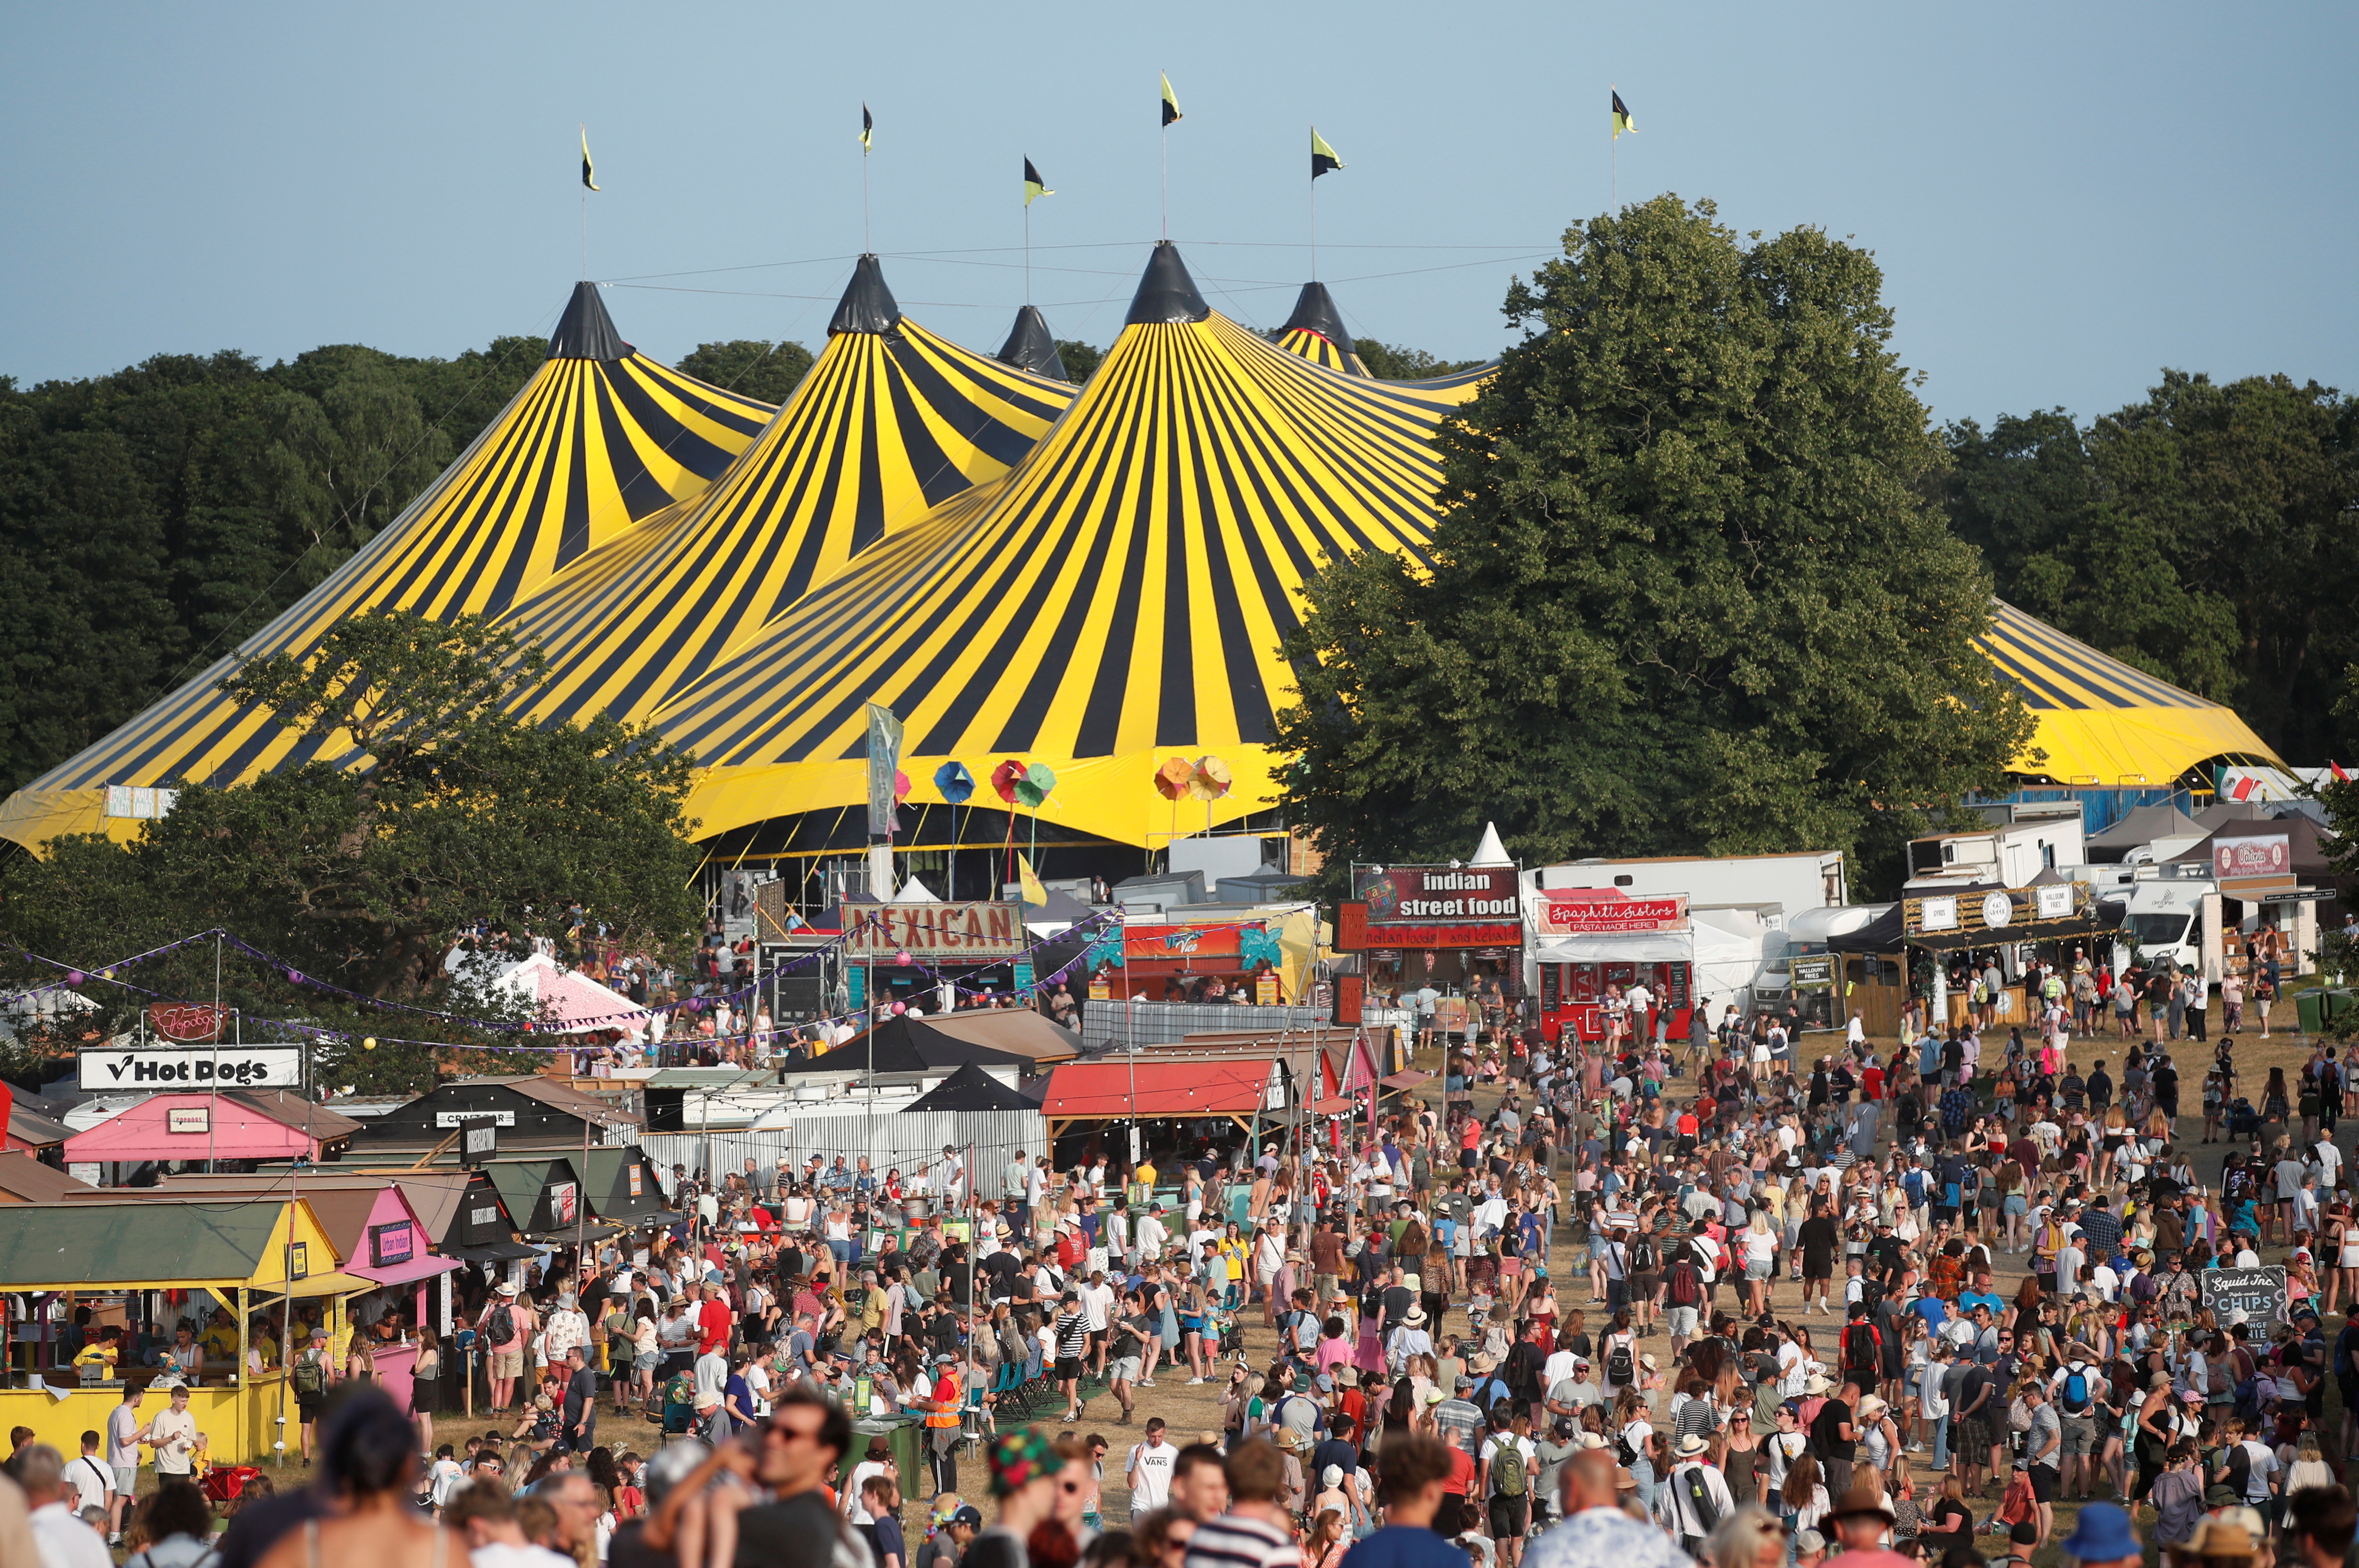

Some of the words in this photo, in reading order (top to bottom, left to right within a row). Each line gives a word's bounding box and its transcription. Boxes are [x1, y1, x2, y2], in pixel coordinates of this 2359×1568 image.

[134, 787, 152, 802] MALE
[2238, 844, 2266, 870] Oatopia
[1423, 872, 1490, 890] indian
[1400, 898, 1464, 916] street
[1468, 896, 1516, 915] food
[853, 908, 1013, 948] MEXICAN
[1574, 923, 1601, 931] PASTA
[1603, 922, 1628, 930] MADE
[1176, 935, 1198, 953] Vice
[1366, 930, 1403, 944] ndian
[1406, 929, 1437, 944] foods
[1450, 932, 1471, 943] and
[1475, 929, 1518, 942] kebabs
[135, 1061, 189, 1081] Hot
[195, 1059, 268, 1085] Dogs
[382, 1237, 394, 1251] Urban
[395, 1235, 408, 1250] Indian
[2212, 1274, 2249, 1292] Squid
[2250, 1274, 2275, 1287] Inc.
[2218, 1296, 2272, 1311] CHIPS
[1144, 1456, 1167, 1466] VANS
